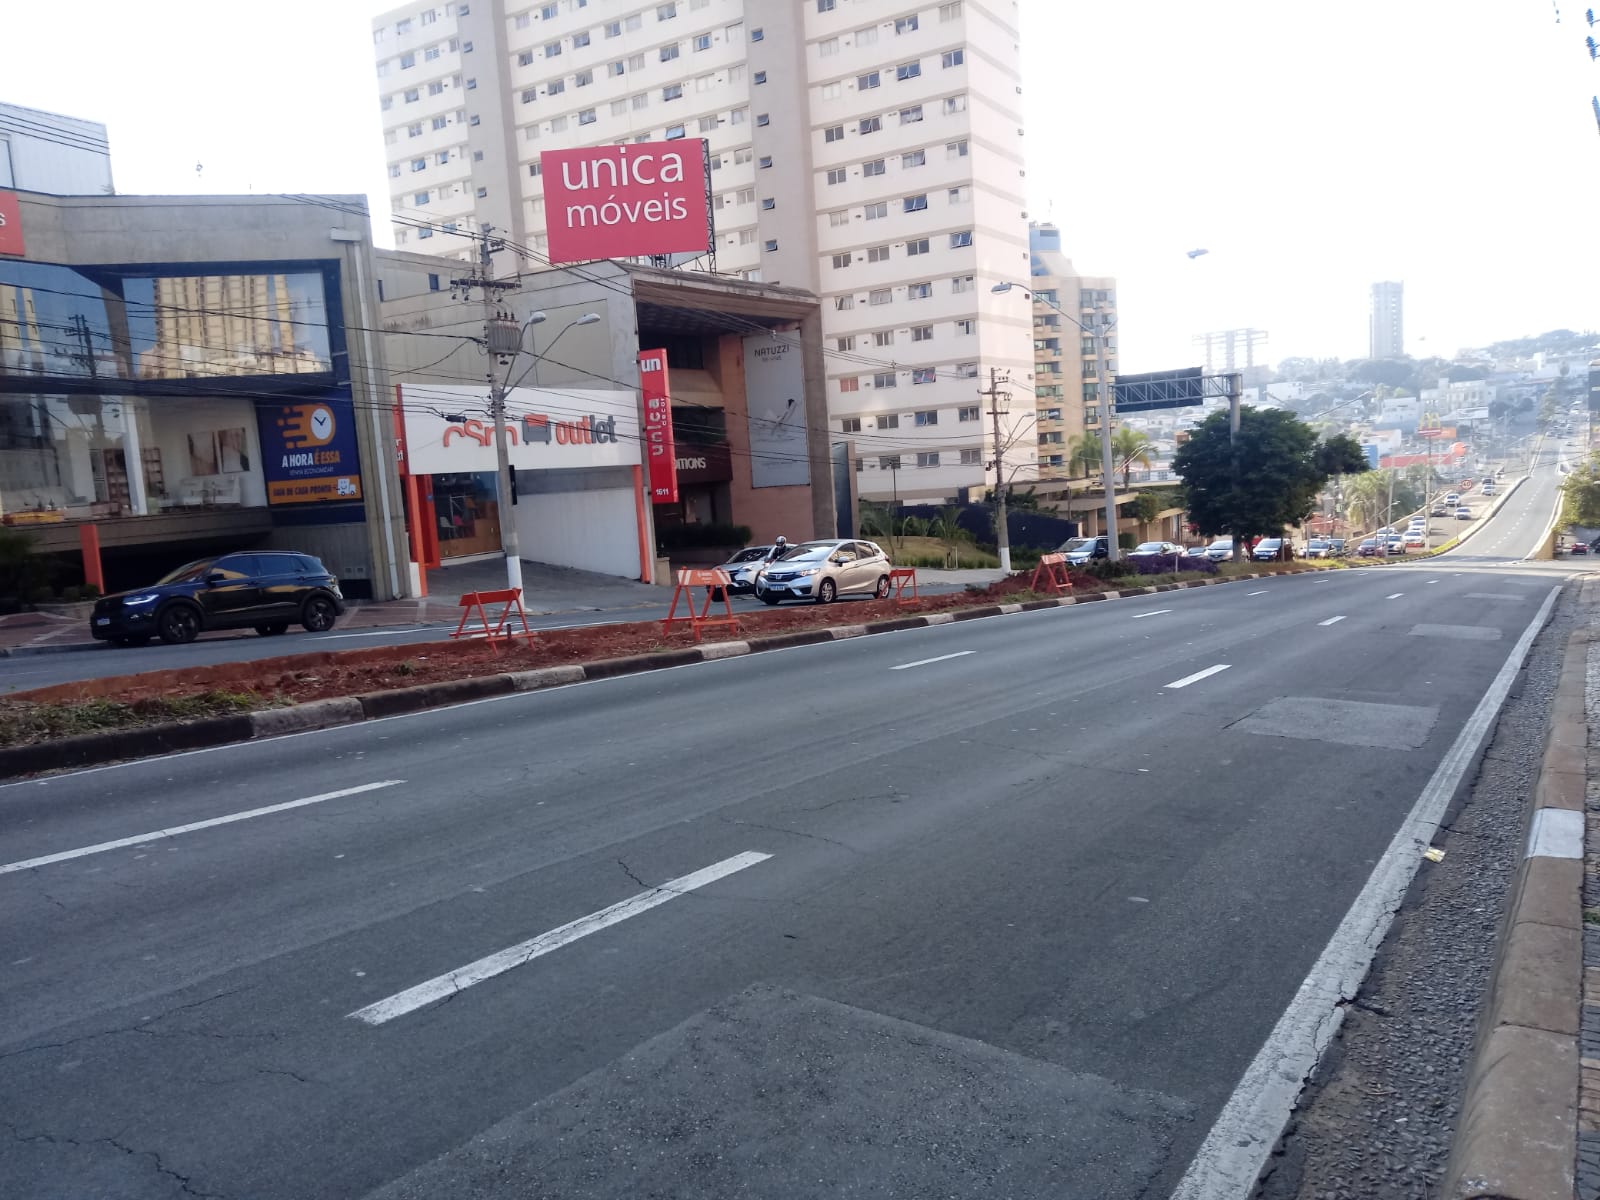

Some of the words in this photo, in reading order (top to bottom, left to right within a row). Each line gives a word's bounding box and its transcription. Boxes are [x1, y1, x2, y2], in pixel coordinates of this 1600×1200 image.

[562, 147, 683, 190] unica
[567, 192, 688, 228] móveis
[641, 358, 661, 372] un
[754, 344, 789, 357] NATUZZI
[555, 414, 618, 445] outlet
[648, 398, 664, 456] unica
[282, 455, 289, 468] A
[290, 453, 314, 467] HORA
[321, 451, 341, 464] ESSA
